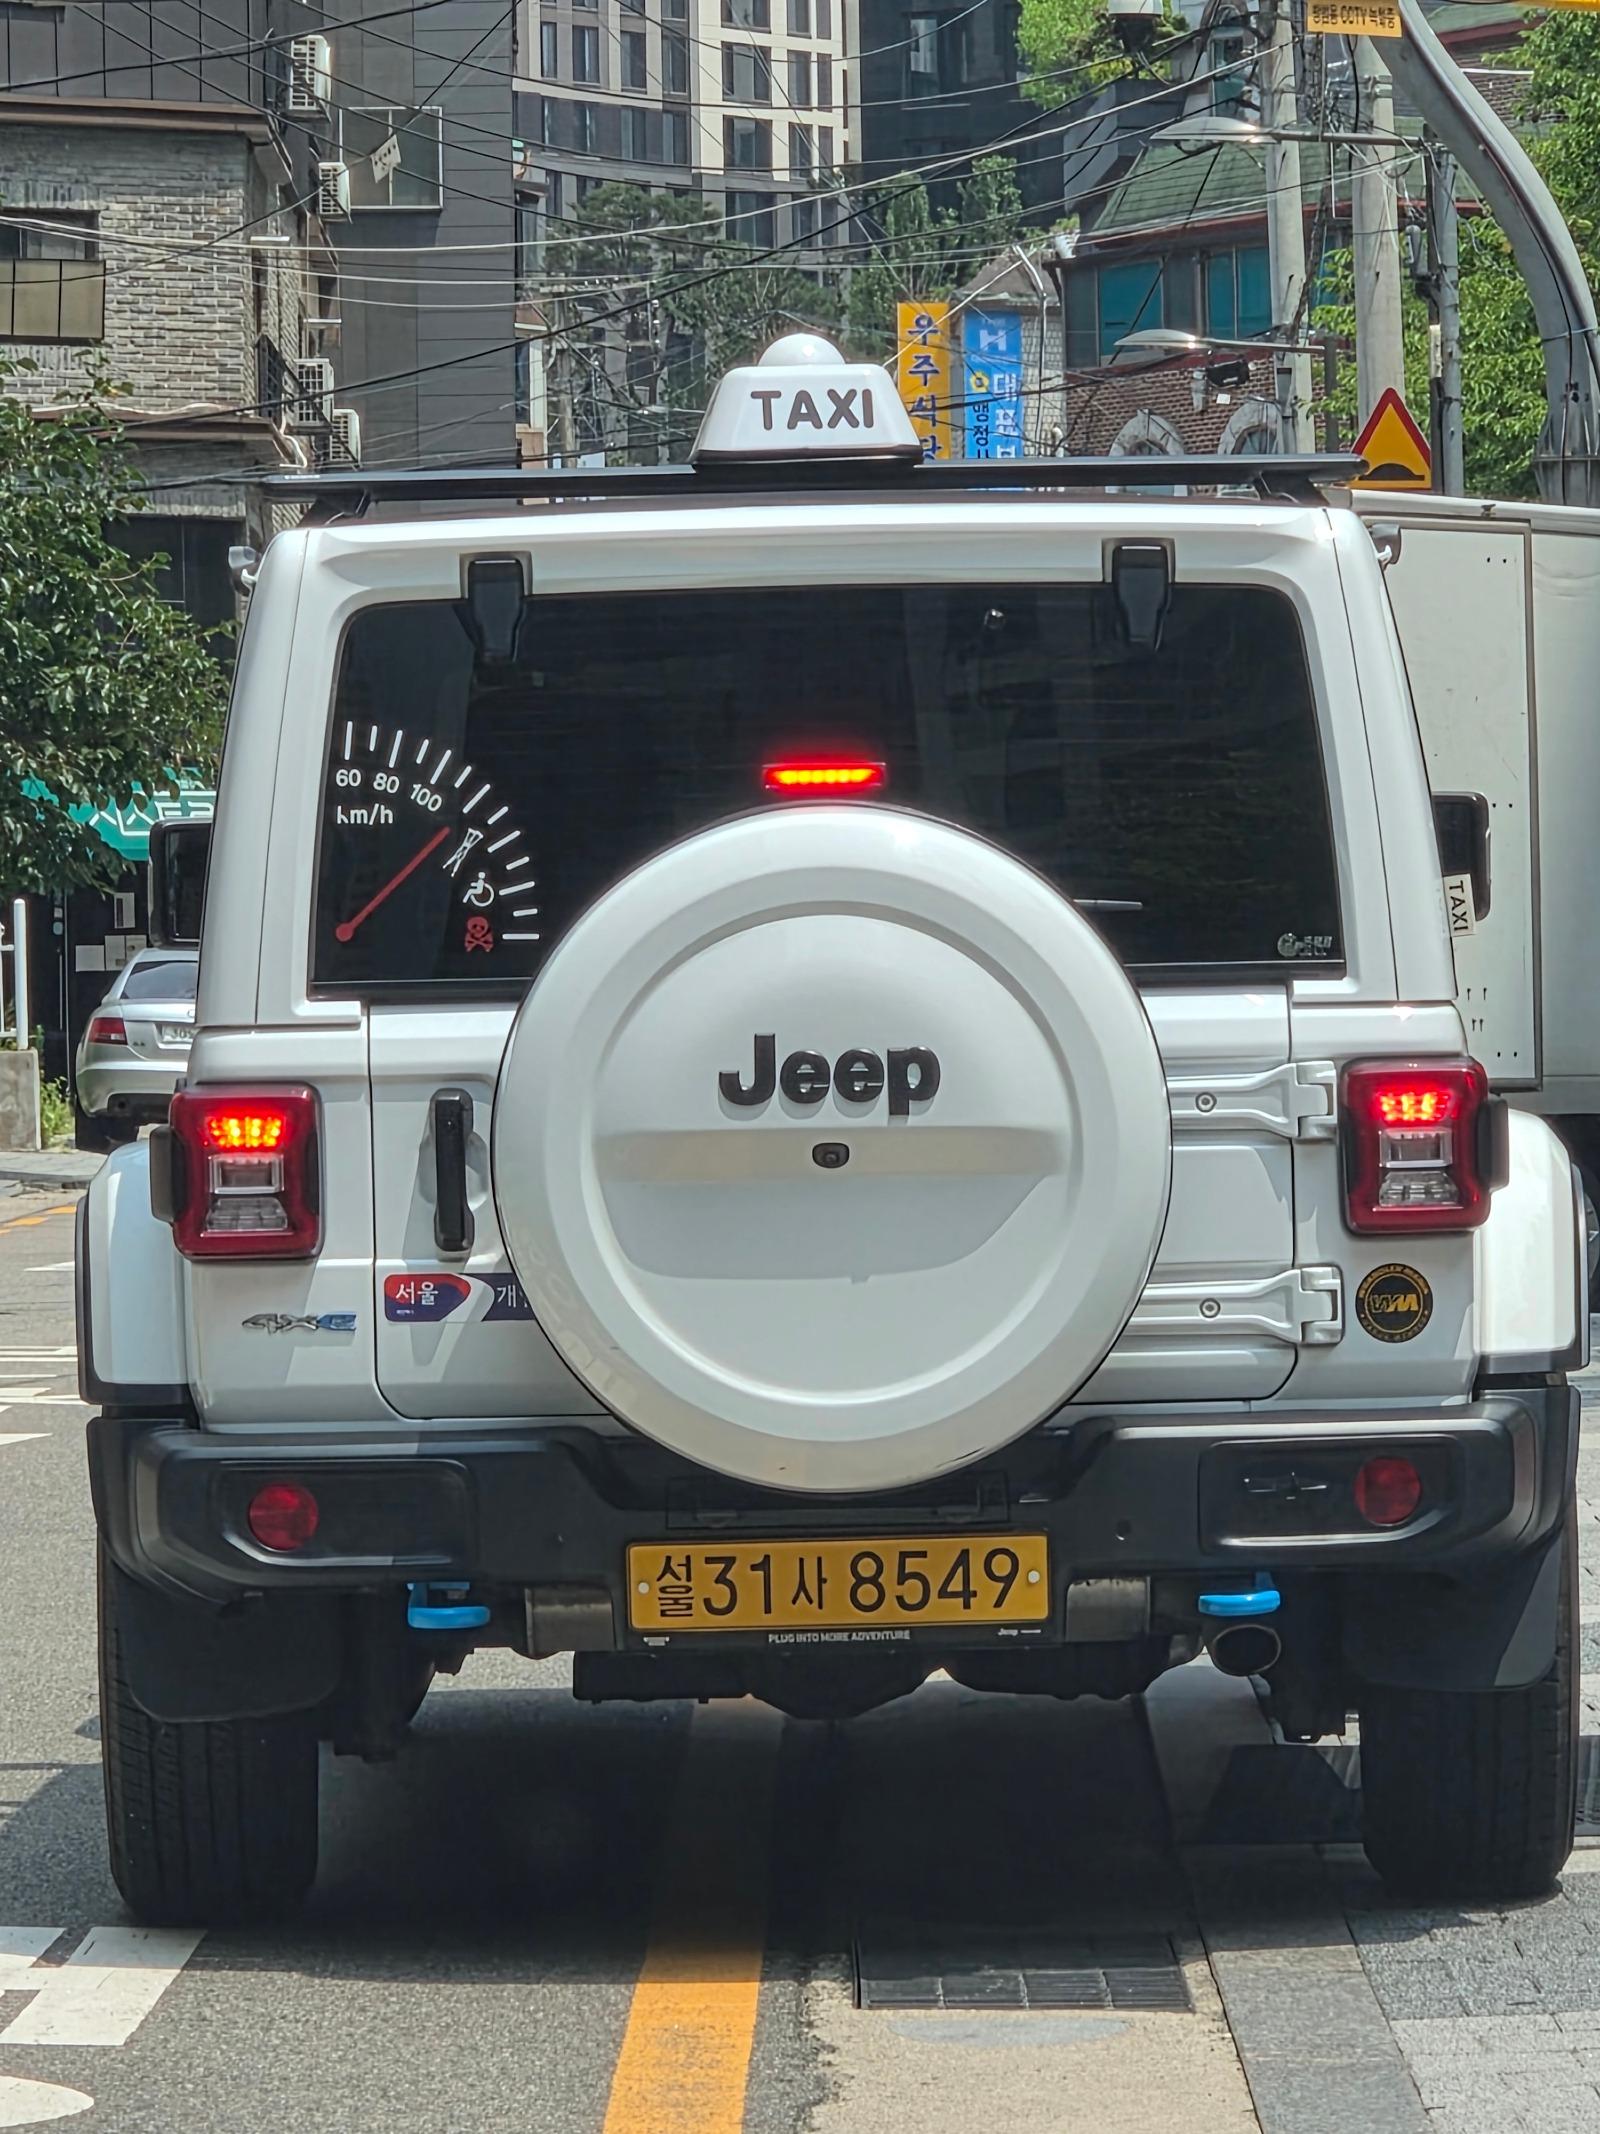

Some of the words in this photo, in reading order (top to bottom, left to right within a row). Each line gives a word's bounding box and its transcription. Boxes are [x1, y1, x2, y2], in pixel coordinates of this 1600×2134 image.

[1341, 5, 1367, 26] CCTV
[750, 388, 874, 431] TAXI
[336, 769, 361, 787] 60
[373, 773, 399, 793] 80
[410, 784, 442, 812] 100
[336, 803, 394, 825] km/h
[1449, 880, 1469, 931] TAXI
[719, 1033, 941, 1115] Jeep
[396, 1281, 438, 1306] 서울
[497, 1284, 530, 1308] 개
[848, 1548, 1020, 1613] 8549
[768, 1633, 795, 1643] PLUG
[796, 1632, 819, 1643] INTO
[820, 1632, 849, 1642] MORE
[851, 1630, 911, 1640] ADVENTURE
